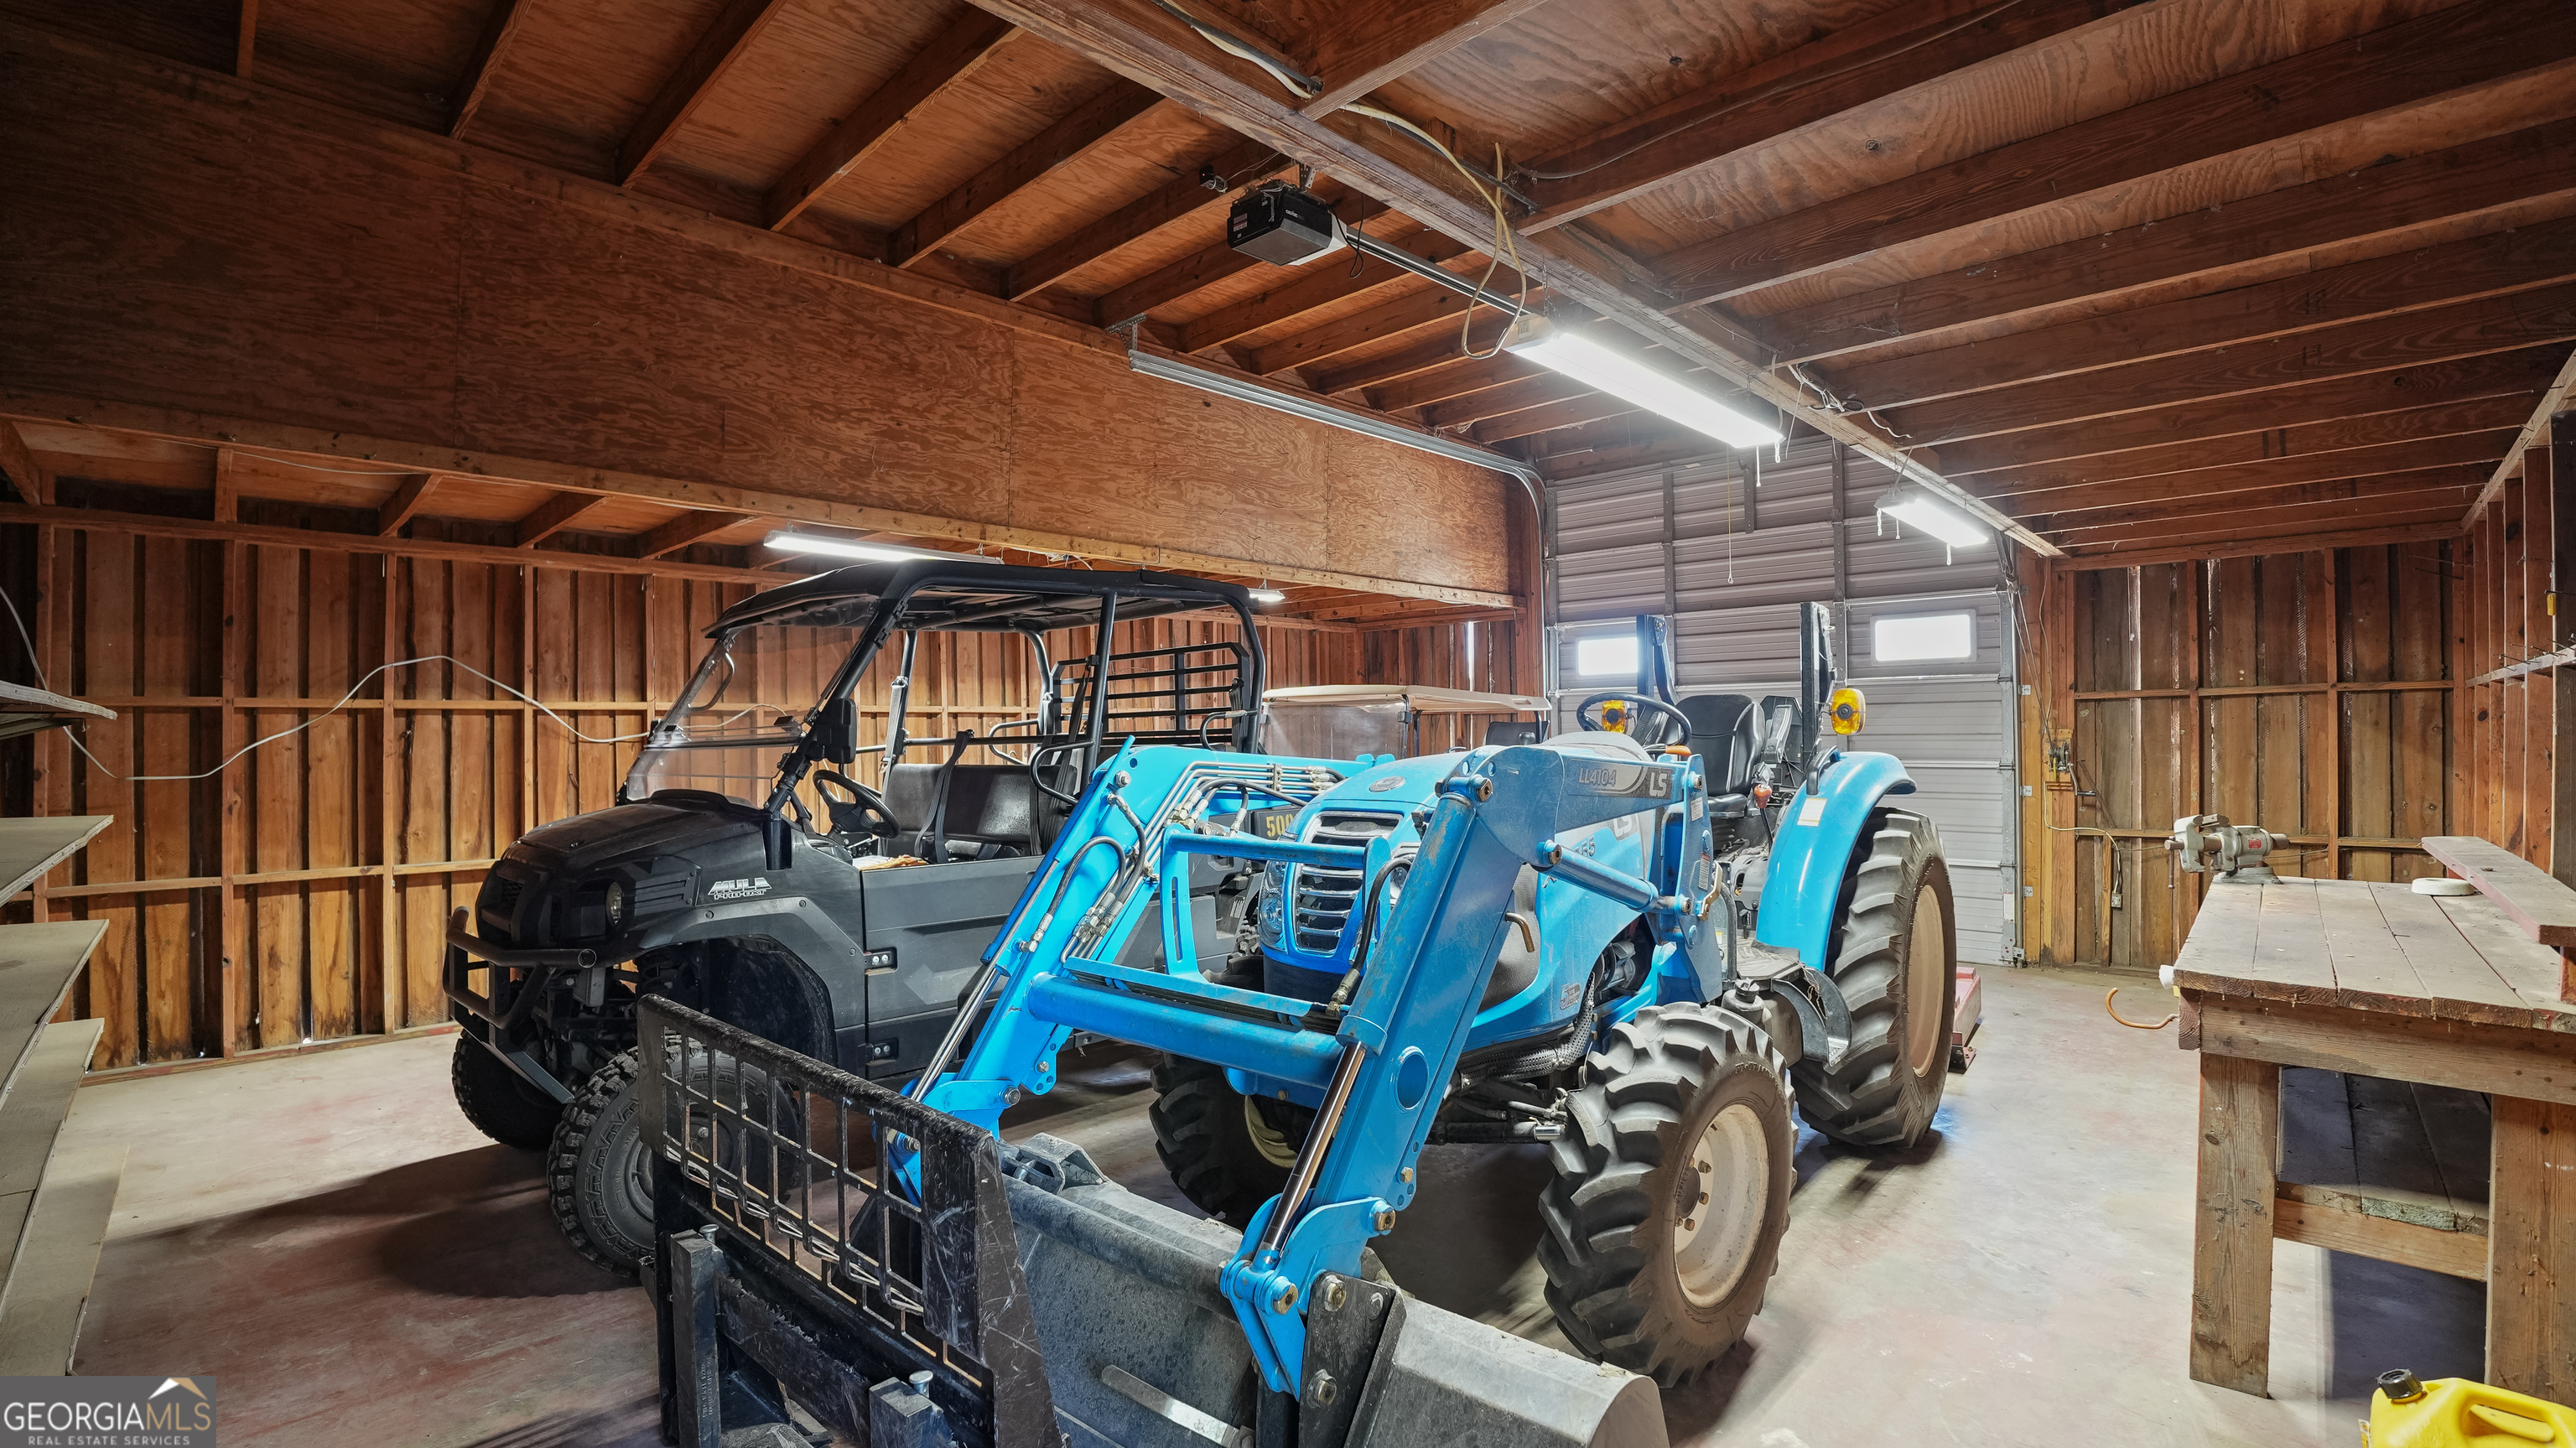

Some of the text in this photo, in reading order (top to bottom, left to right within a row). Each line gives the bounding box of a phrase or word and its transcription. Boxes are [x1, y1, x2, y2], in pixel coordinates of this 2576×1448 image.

[1579, 768, 1618, 787] LL4104
[1649, 772, 1668, 797] LS
[708, 877, 772, 896] MULE
